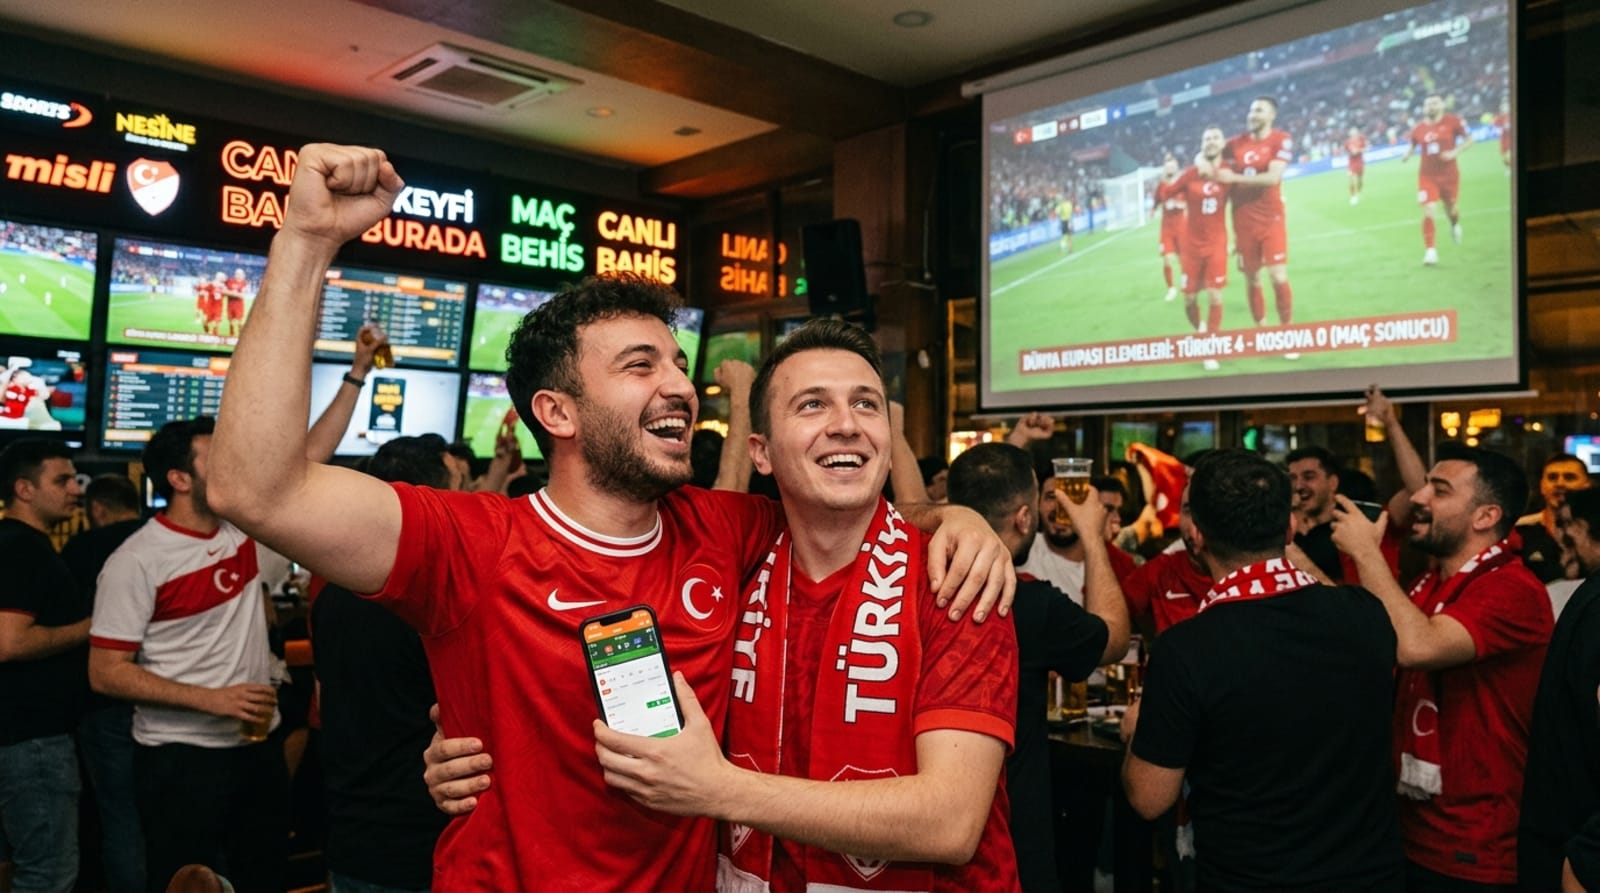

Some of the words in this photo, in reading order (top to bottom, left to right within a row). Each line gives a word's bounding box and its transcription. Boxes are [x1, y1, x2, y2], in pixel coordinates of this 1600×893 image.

[6, 154, 116, 193] misli
[512, 194, 576, 239] MAÇ
[597, 211, 676, 250] CANLI
[361, 218, 487, 258] BURADA
[501, 233, 585, 272] BEHİS
[597, 245, 677, 285] BAHİS
[1176, 333, 1233, 358] TÜRKİYE
[1234, 334, 1245, 353] 4
[1256, 328, 1313, 352] KOSOVA
[1330, 323, 1370, 349] (MAÇ
[1374, 315, 1450, 343] SONUCU)
